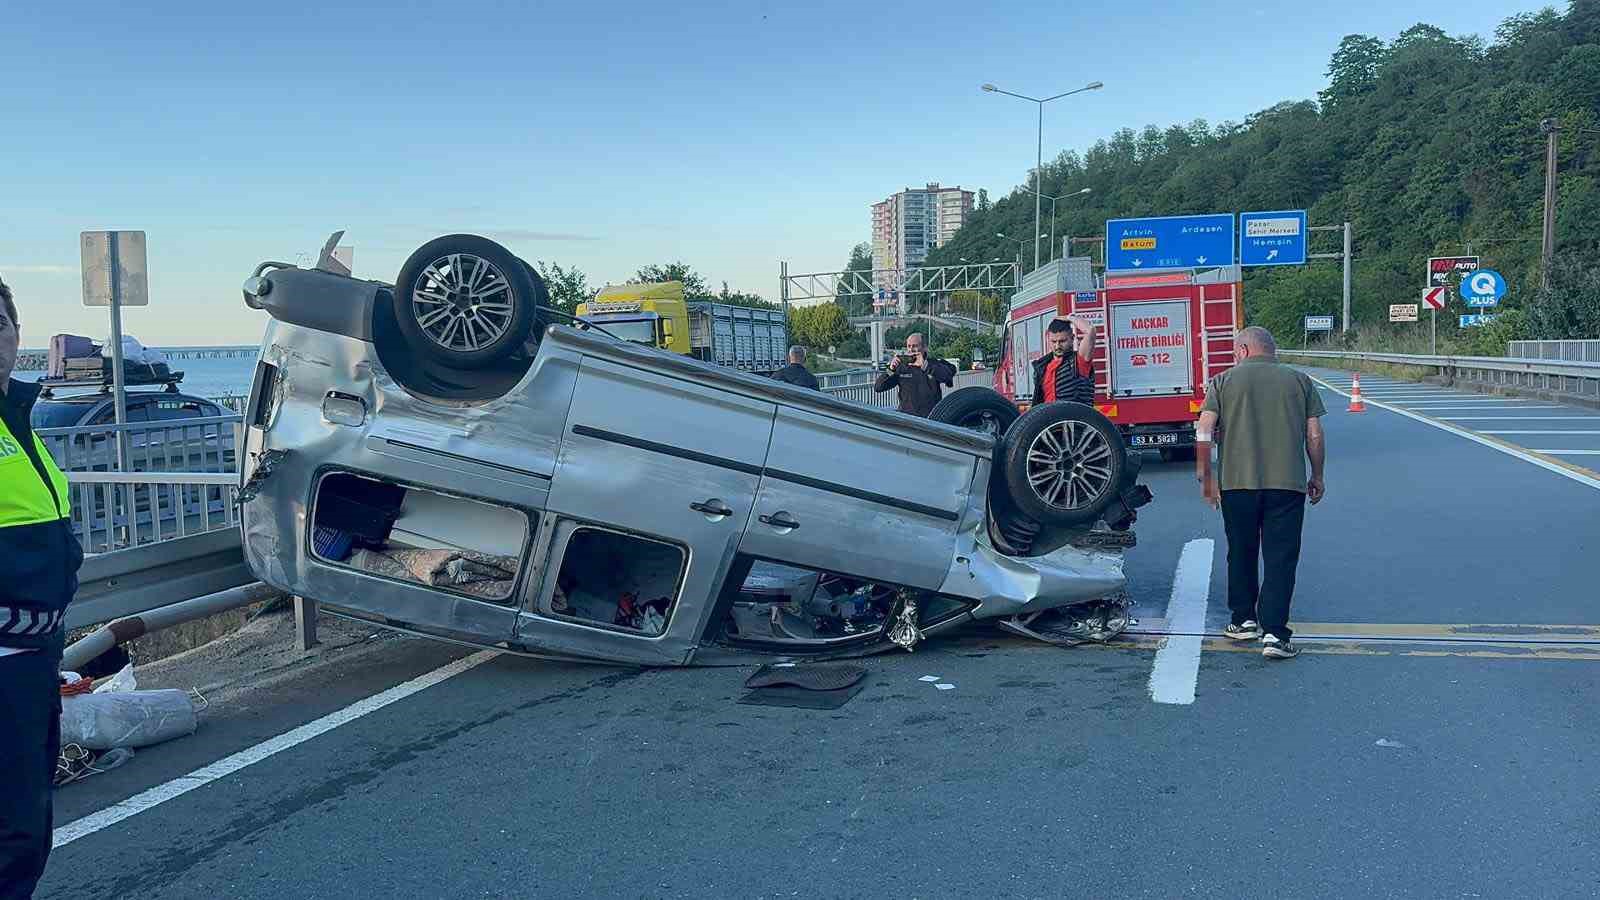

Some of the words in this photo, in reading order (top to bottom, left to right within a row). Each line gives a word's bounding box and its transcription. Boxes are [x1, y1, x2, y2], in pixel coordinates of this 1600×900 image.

[1122, 229, 1153, 237] Artvin
[1454, 262, 1477, 270] AUTO
[1471, 272, 1496, 296] Q
[1469, 296, 1496, 305] PLUS
[1132, 317, 1168, 329] KAÇKAR
[1152, 353, 1170, 364] 112
[1136, 436, 1146, 444] 53
